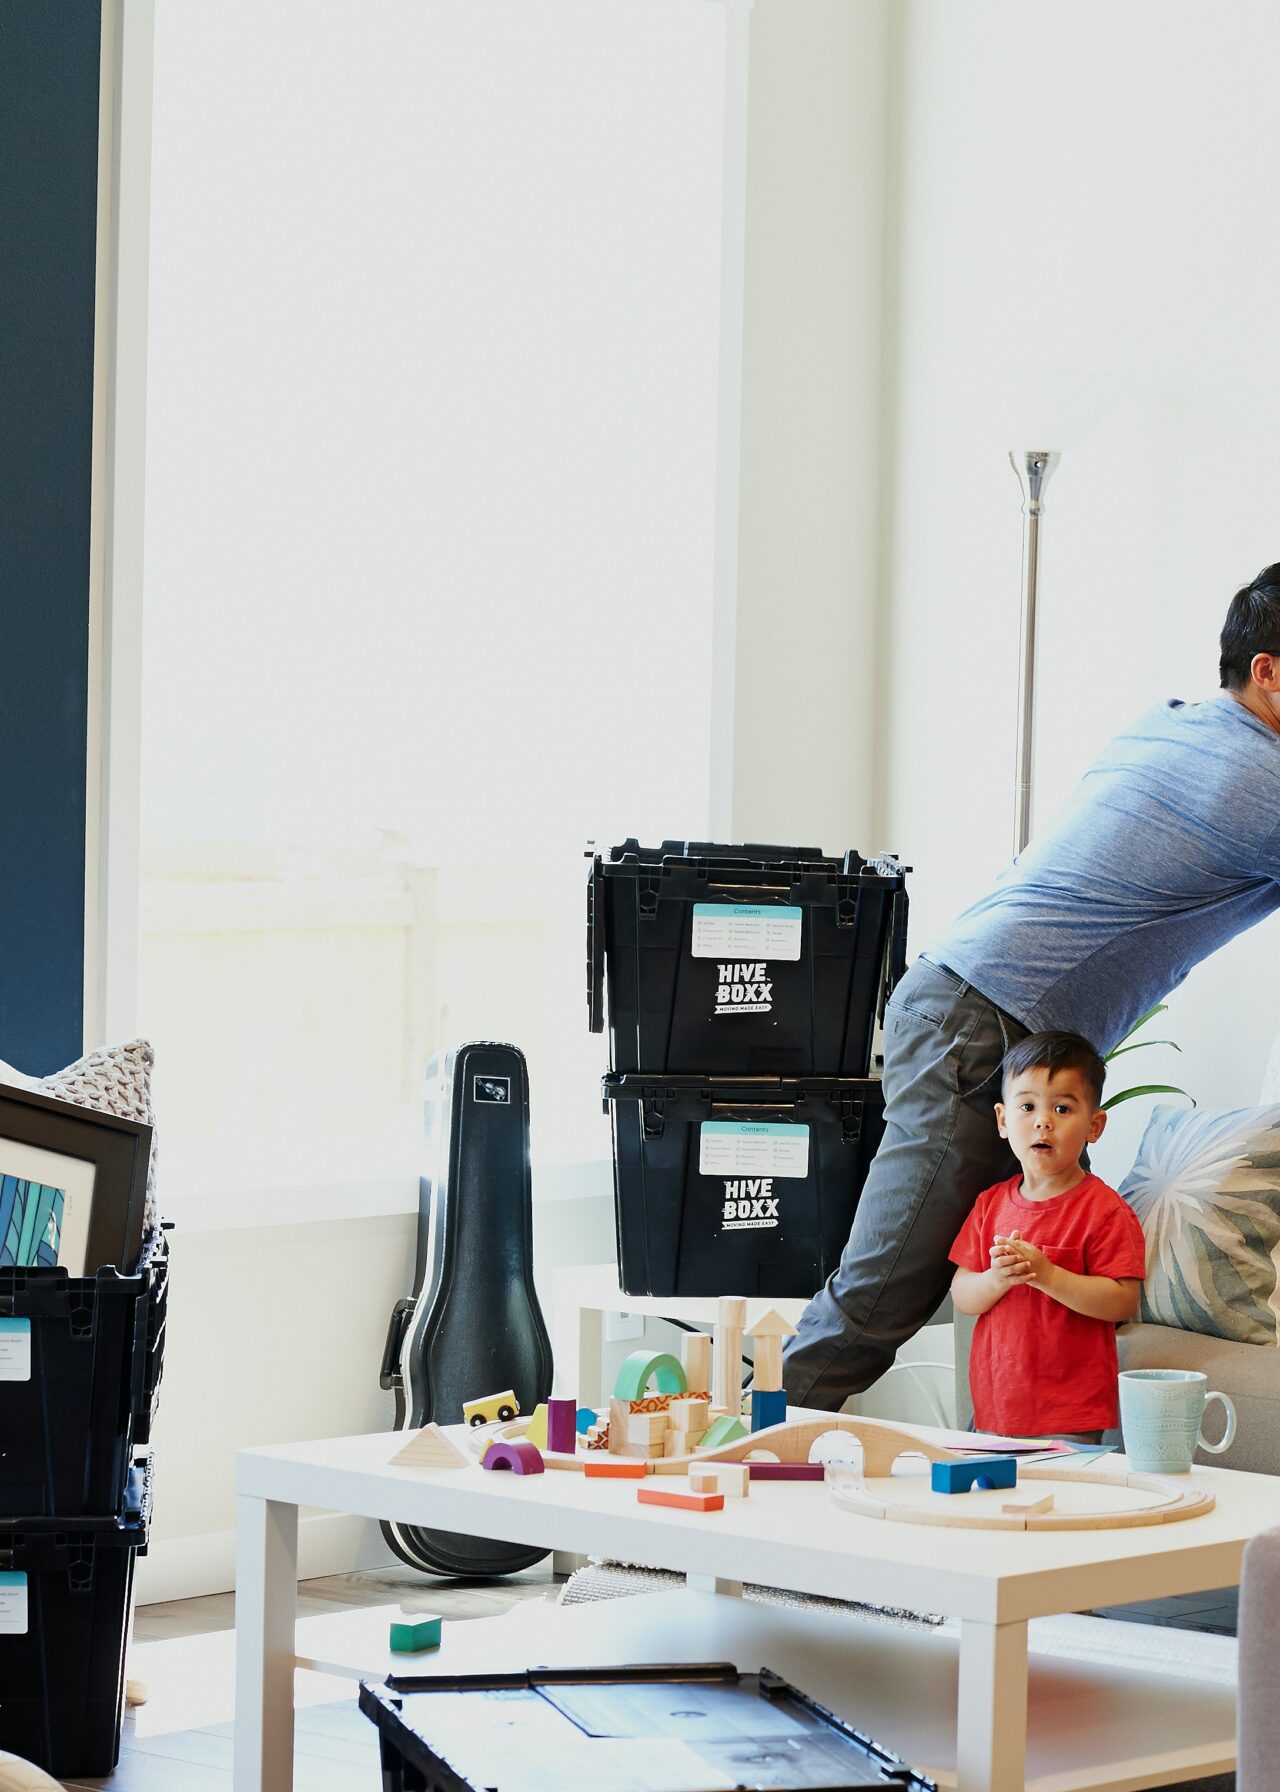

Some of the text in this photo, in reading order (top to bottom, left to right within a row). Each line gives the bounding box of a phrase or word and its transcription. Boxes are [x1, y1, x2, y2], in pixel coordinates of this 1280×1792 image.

[733, 907, 761, 916] Contents
[717, 963, 767, 983] HIVE
[714, 983, 773, 1003] BOXX
[741, 1126, 769, 1134] Contents
[723, 1179, 773, 1199] HIVE
[721, 1198, 780, 1219] BOXX
